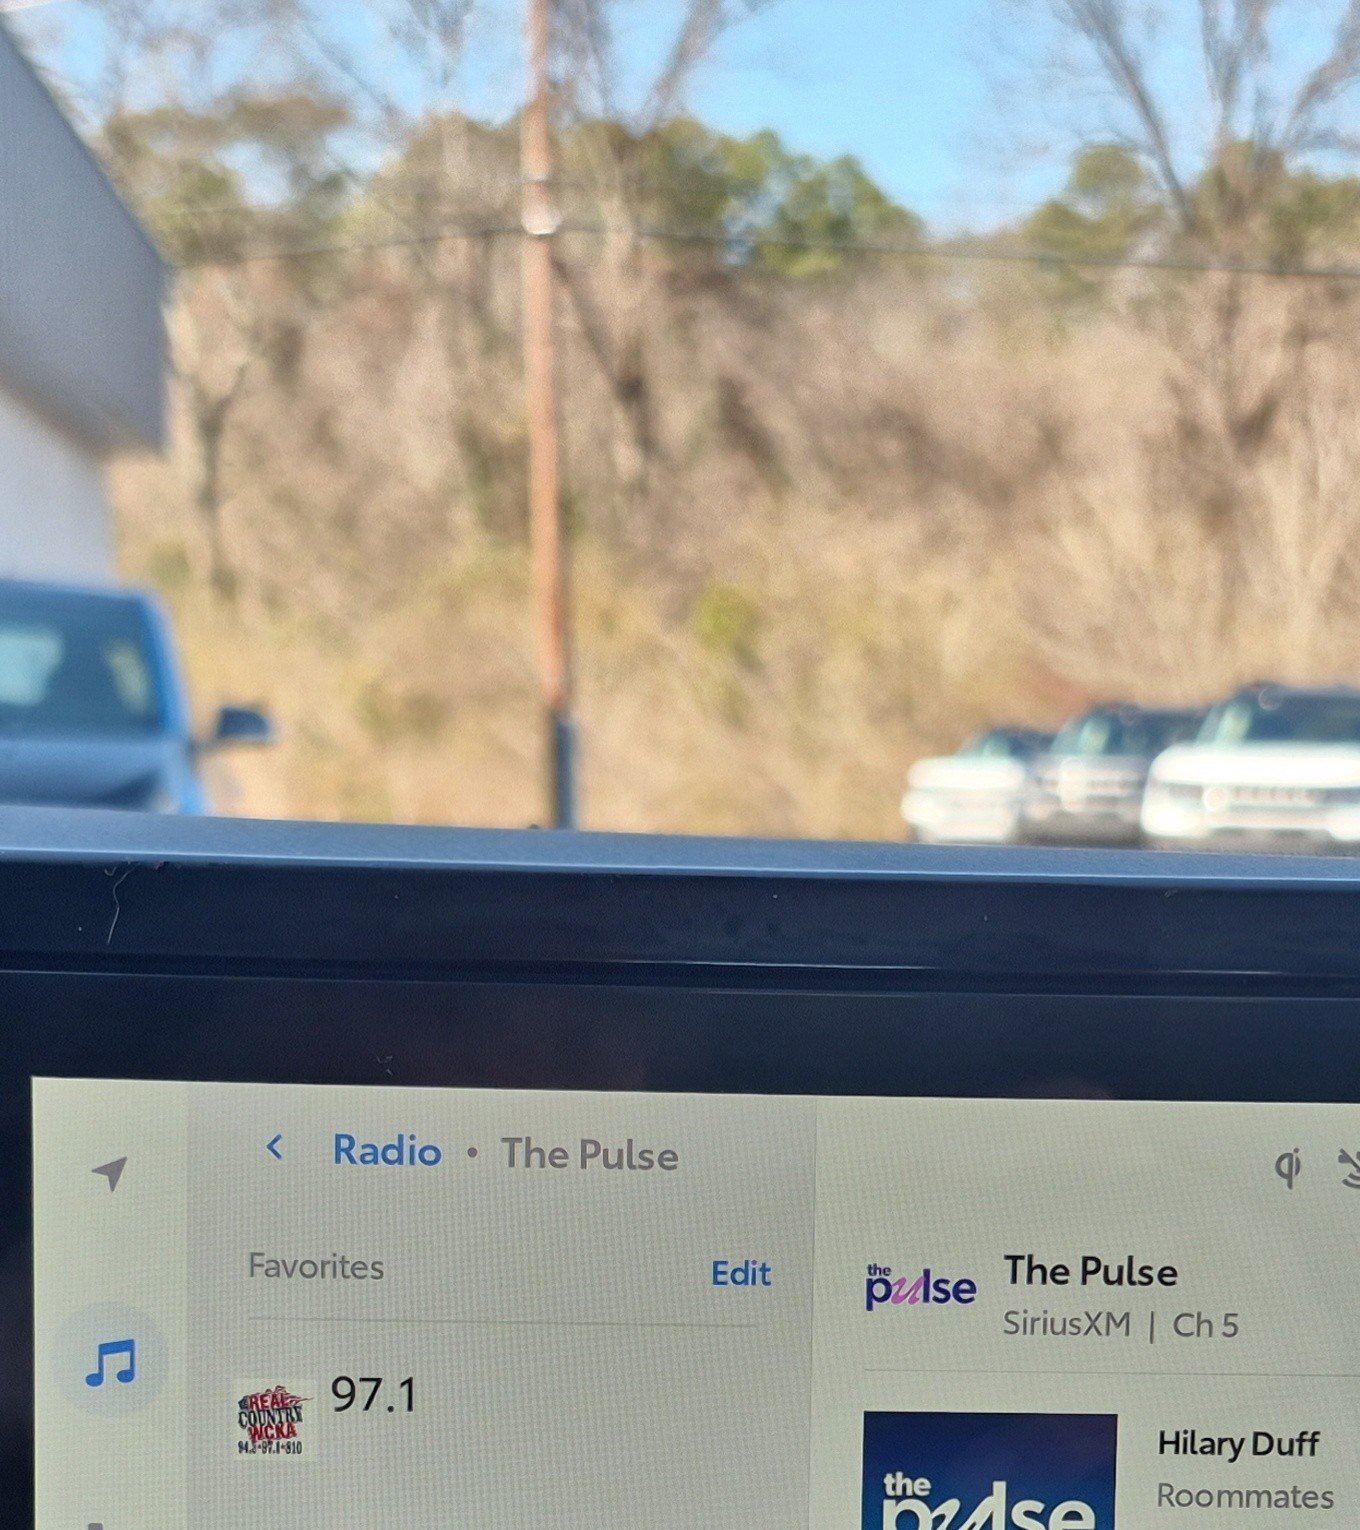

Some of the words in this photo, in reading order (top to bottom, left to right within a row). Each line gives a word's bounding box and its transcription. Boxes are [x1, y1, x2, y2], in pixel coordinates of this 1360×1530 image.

[334, 1133, 442, 1168] Radio
[501, 1137, 570, 1170] The
[580, 1139, 680, 1173] Pulse
[248, 1251, 385, 1281] Favorites
[711, 1259, 773, 1288] Edit
[867, 1263, 892, 1278] the
[1003, 1254, 1071, 1286] The
[1080, 1255, 1179, 1287] Pulse
[866, 1269, 977, 1311] pulse
[1003, 1310, 1132, 1337] SiriusXM
[1173, 1312, 1214, 1339] Ch
[1221, 1313, 1240, 1339] 5
[248, 1392, 288, 1411] REAL
[331, 1375, 414, 1413] 97.1
[1158, 1429, 1246, 1463] Hilary
[1251, 1430, 1321, 1457] Duff
[883, 1471, 932, 1497] the
[1157, 1482, 1335, 1510] Roommates
